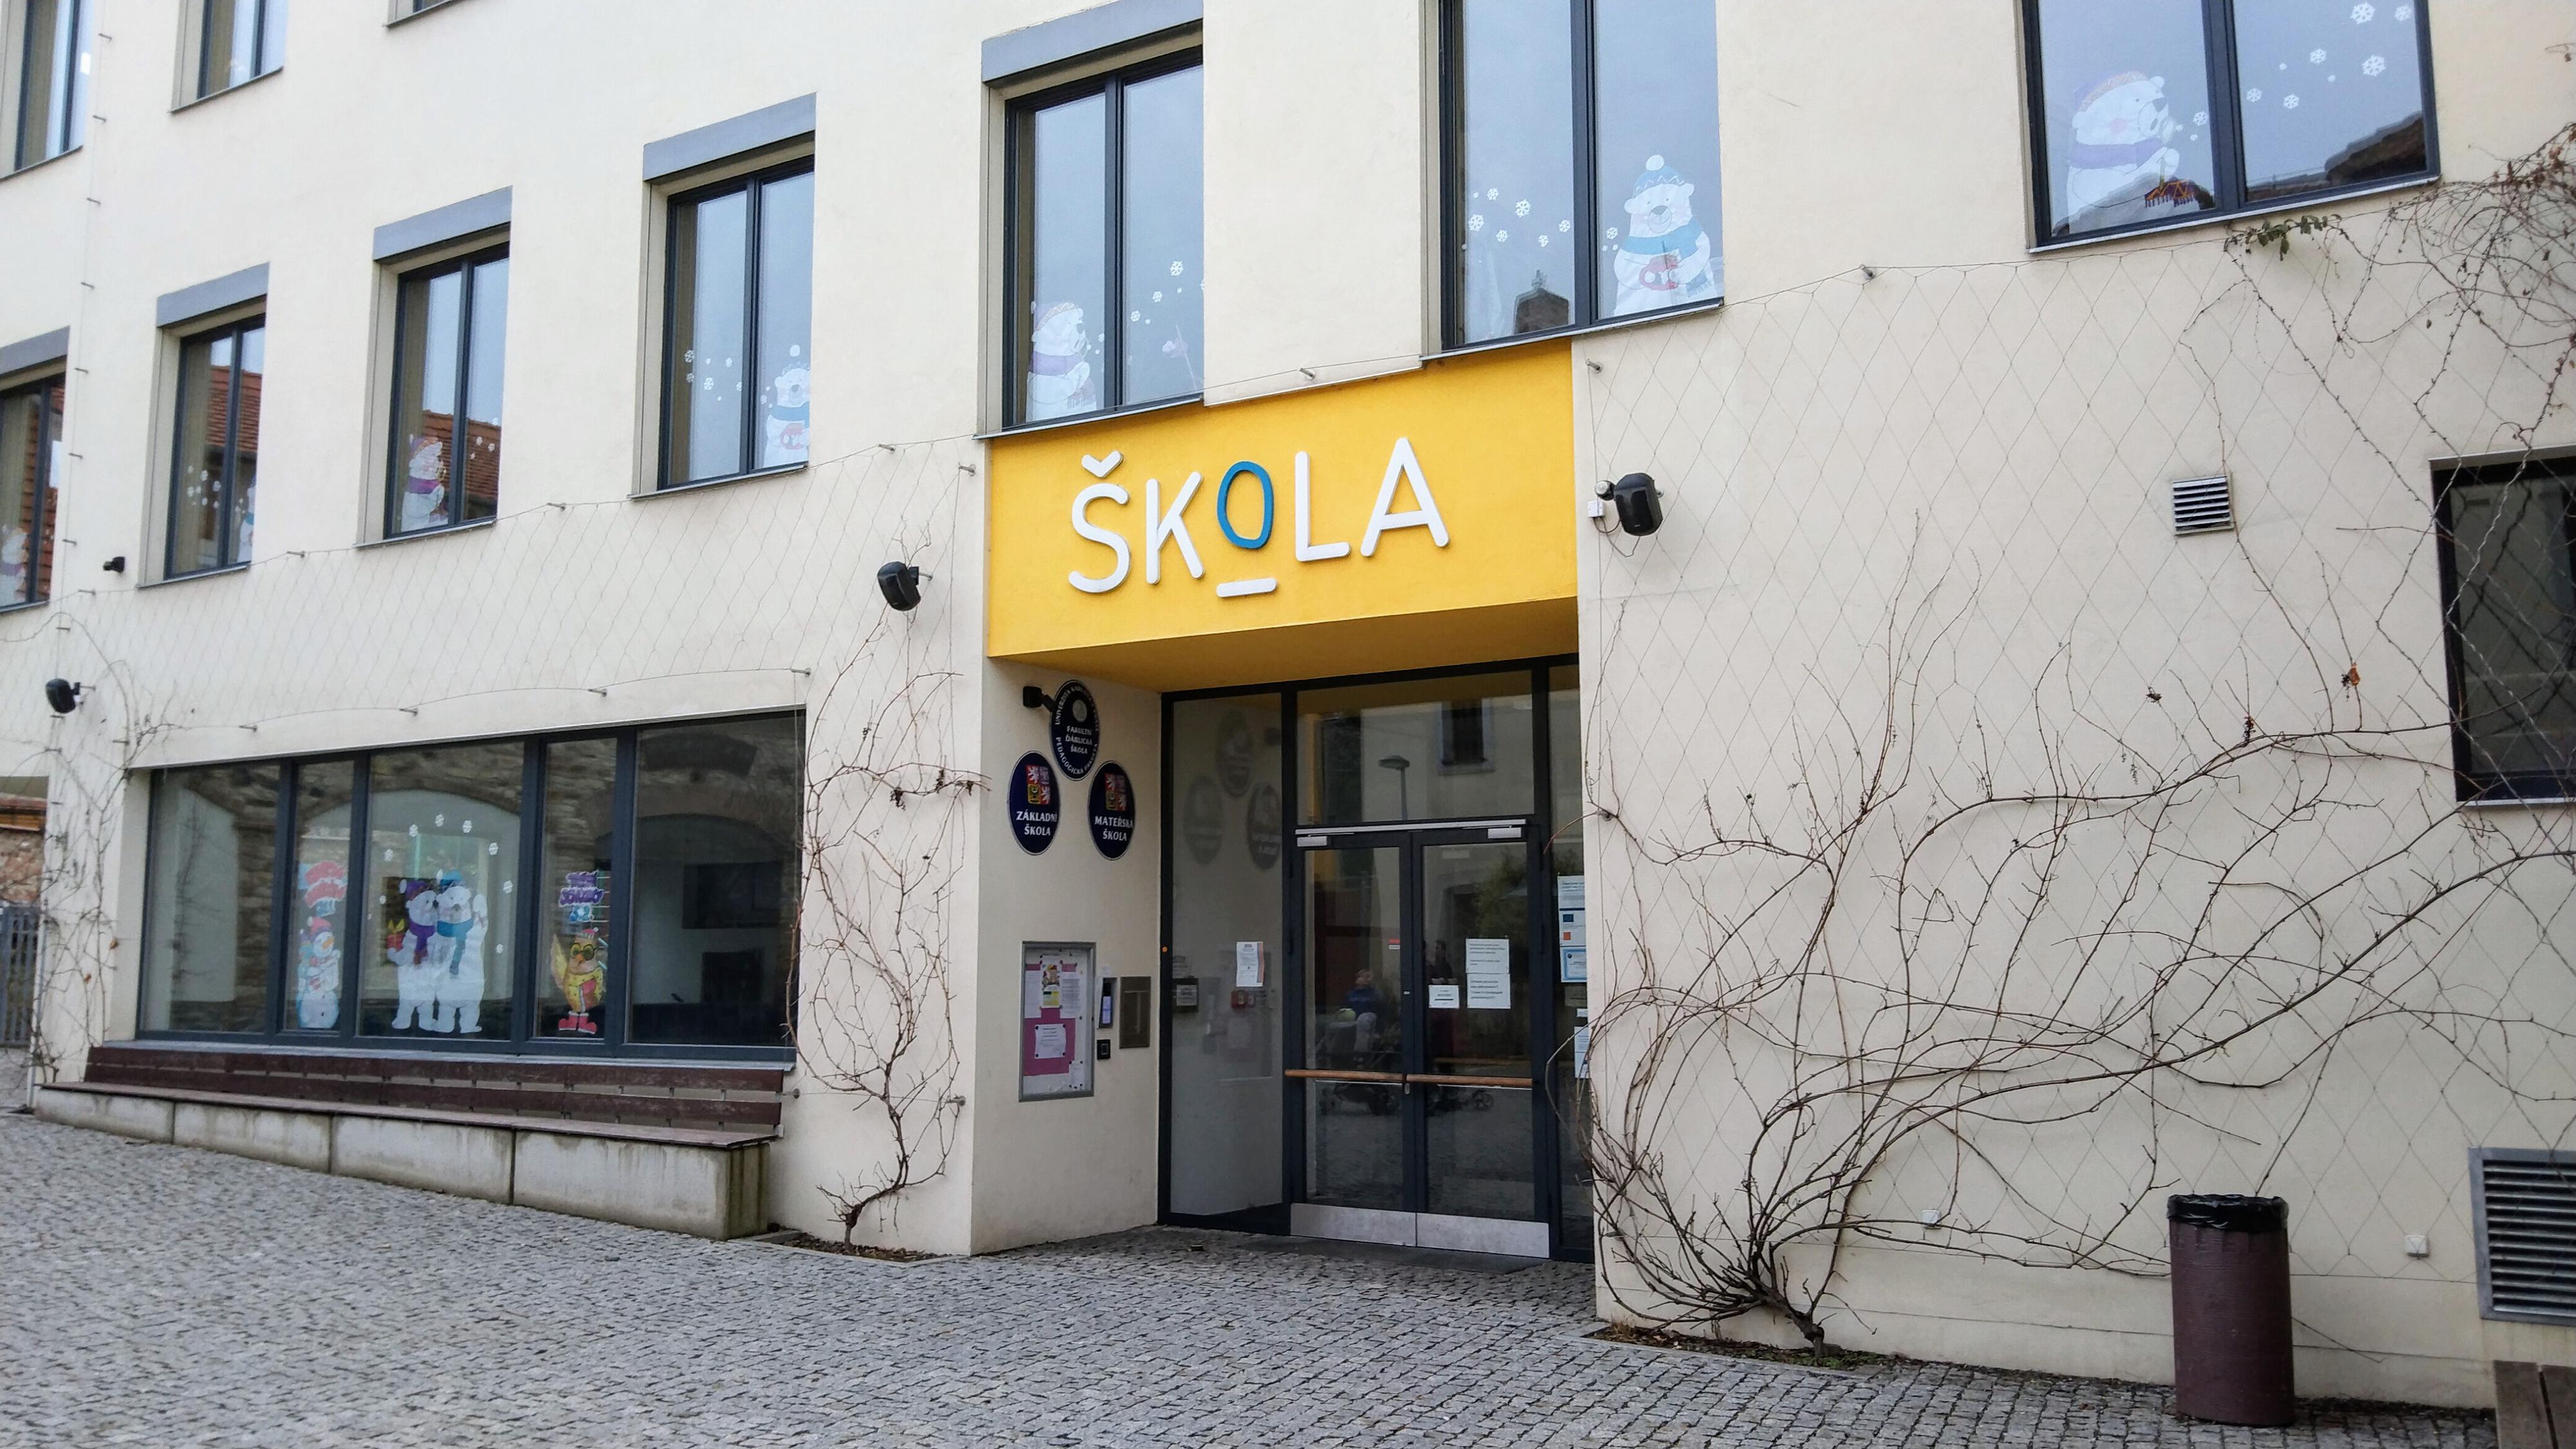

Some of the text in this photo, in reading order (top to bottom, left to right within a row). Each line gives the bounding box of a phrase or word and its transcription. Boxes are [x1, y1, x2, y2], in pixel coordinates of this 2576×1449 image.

[1068, 437, 1450, 594] ŠKOLA
[1016, 809, 1057, 822] ZÁKLADNÍ
[1024, 823, 1051, 836] ŠKOLA
[1102, 828, 1128, 841] ŠKOLA
